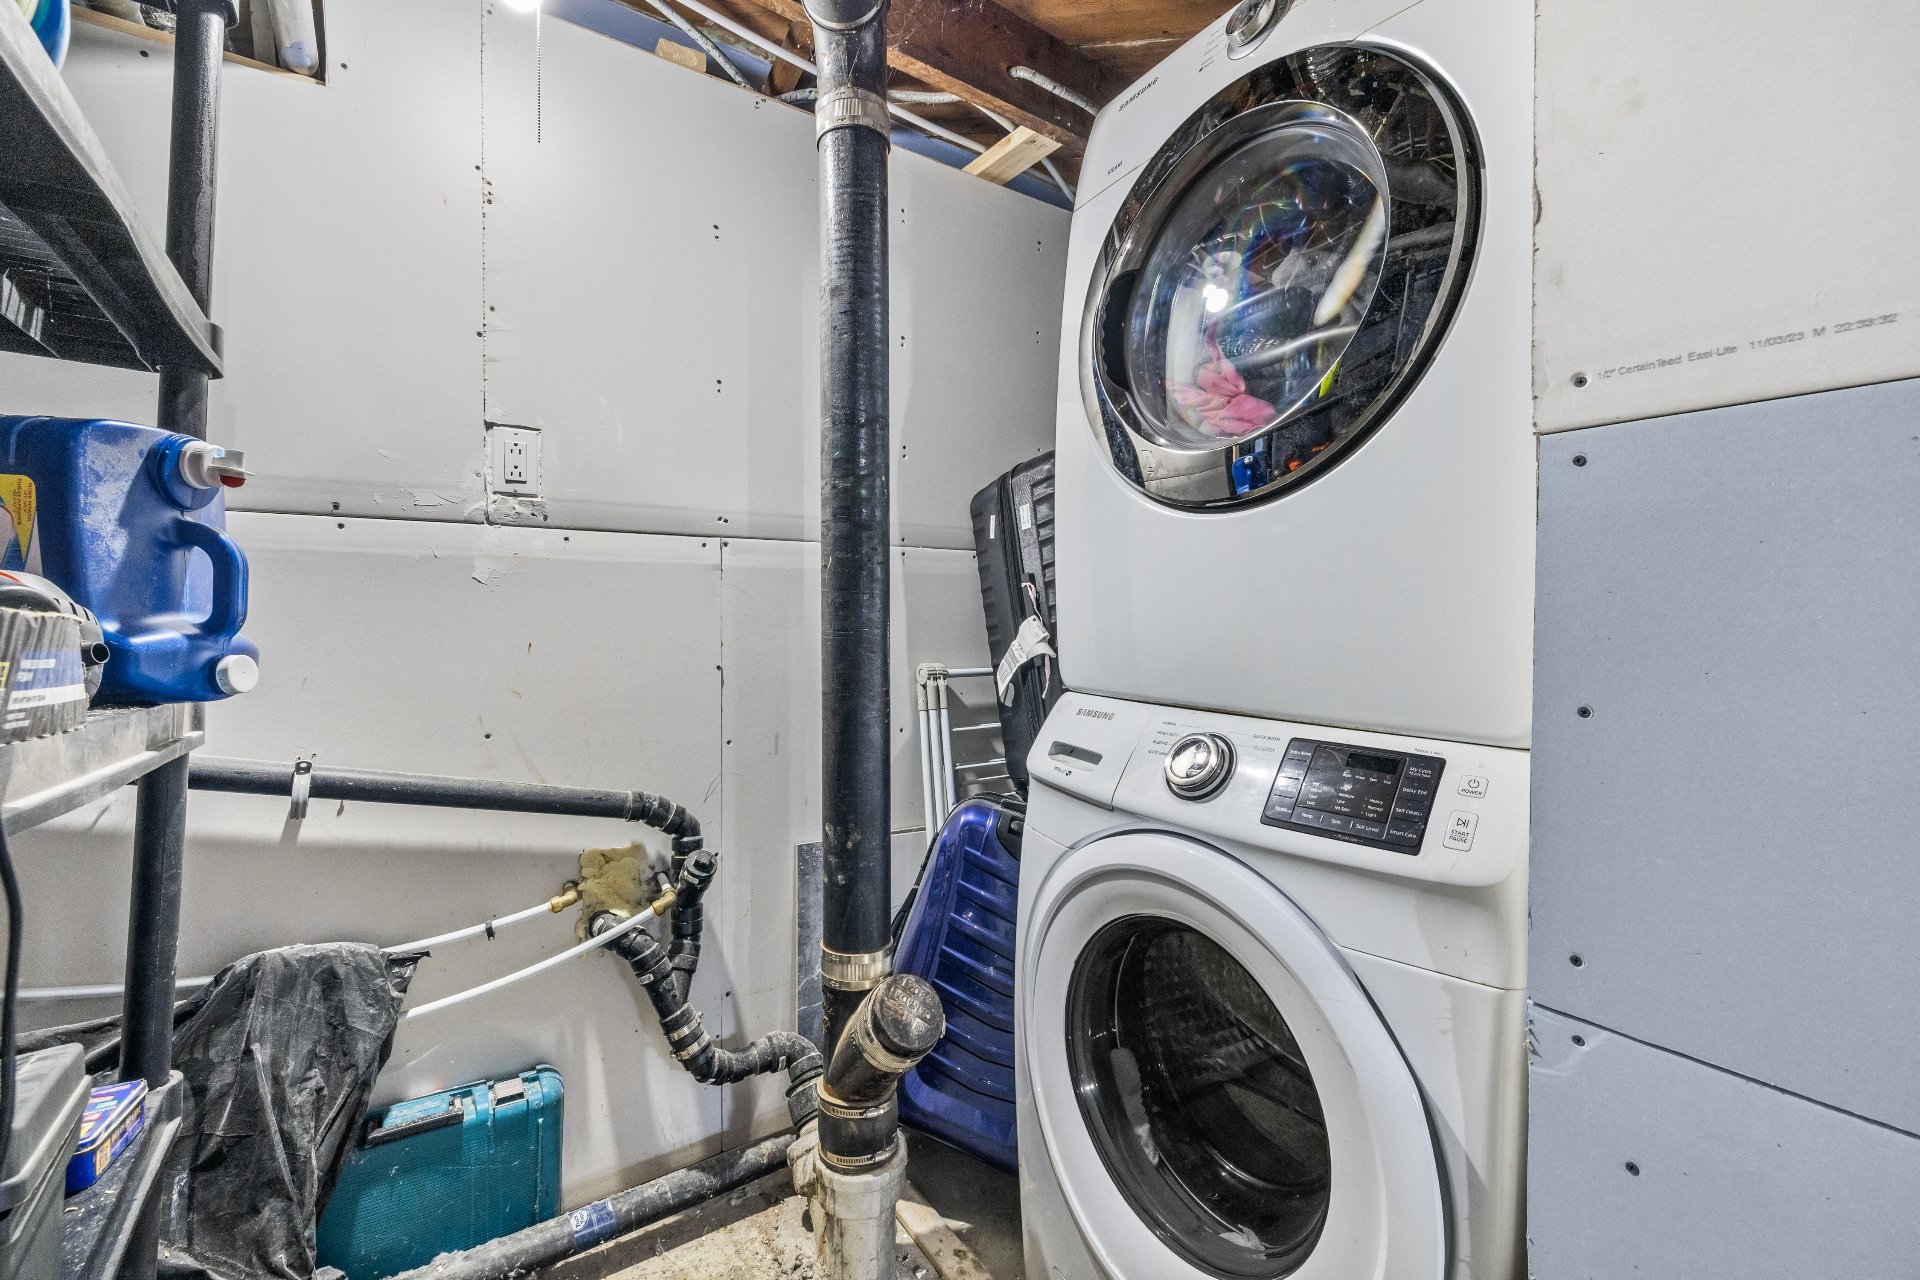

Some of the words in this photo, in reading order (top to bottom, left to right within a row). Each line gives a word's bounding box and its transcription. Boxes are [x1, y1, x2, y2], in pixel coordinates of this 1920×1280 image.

[1118, 76, 1159, 112] SAMSUNG
[1750, 331, 1805, 350] 11/03/23
[1812, 326, 1827, 338] M
[1076, 708, 1115, 721] SAMSUNG
[1461, 788, 1482, 796] POWER
[1450, 829, 1470, 837] START
[1448, 836, 1468, 844] PAUSE
